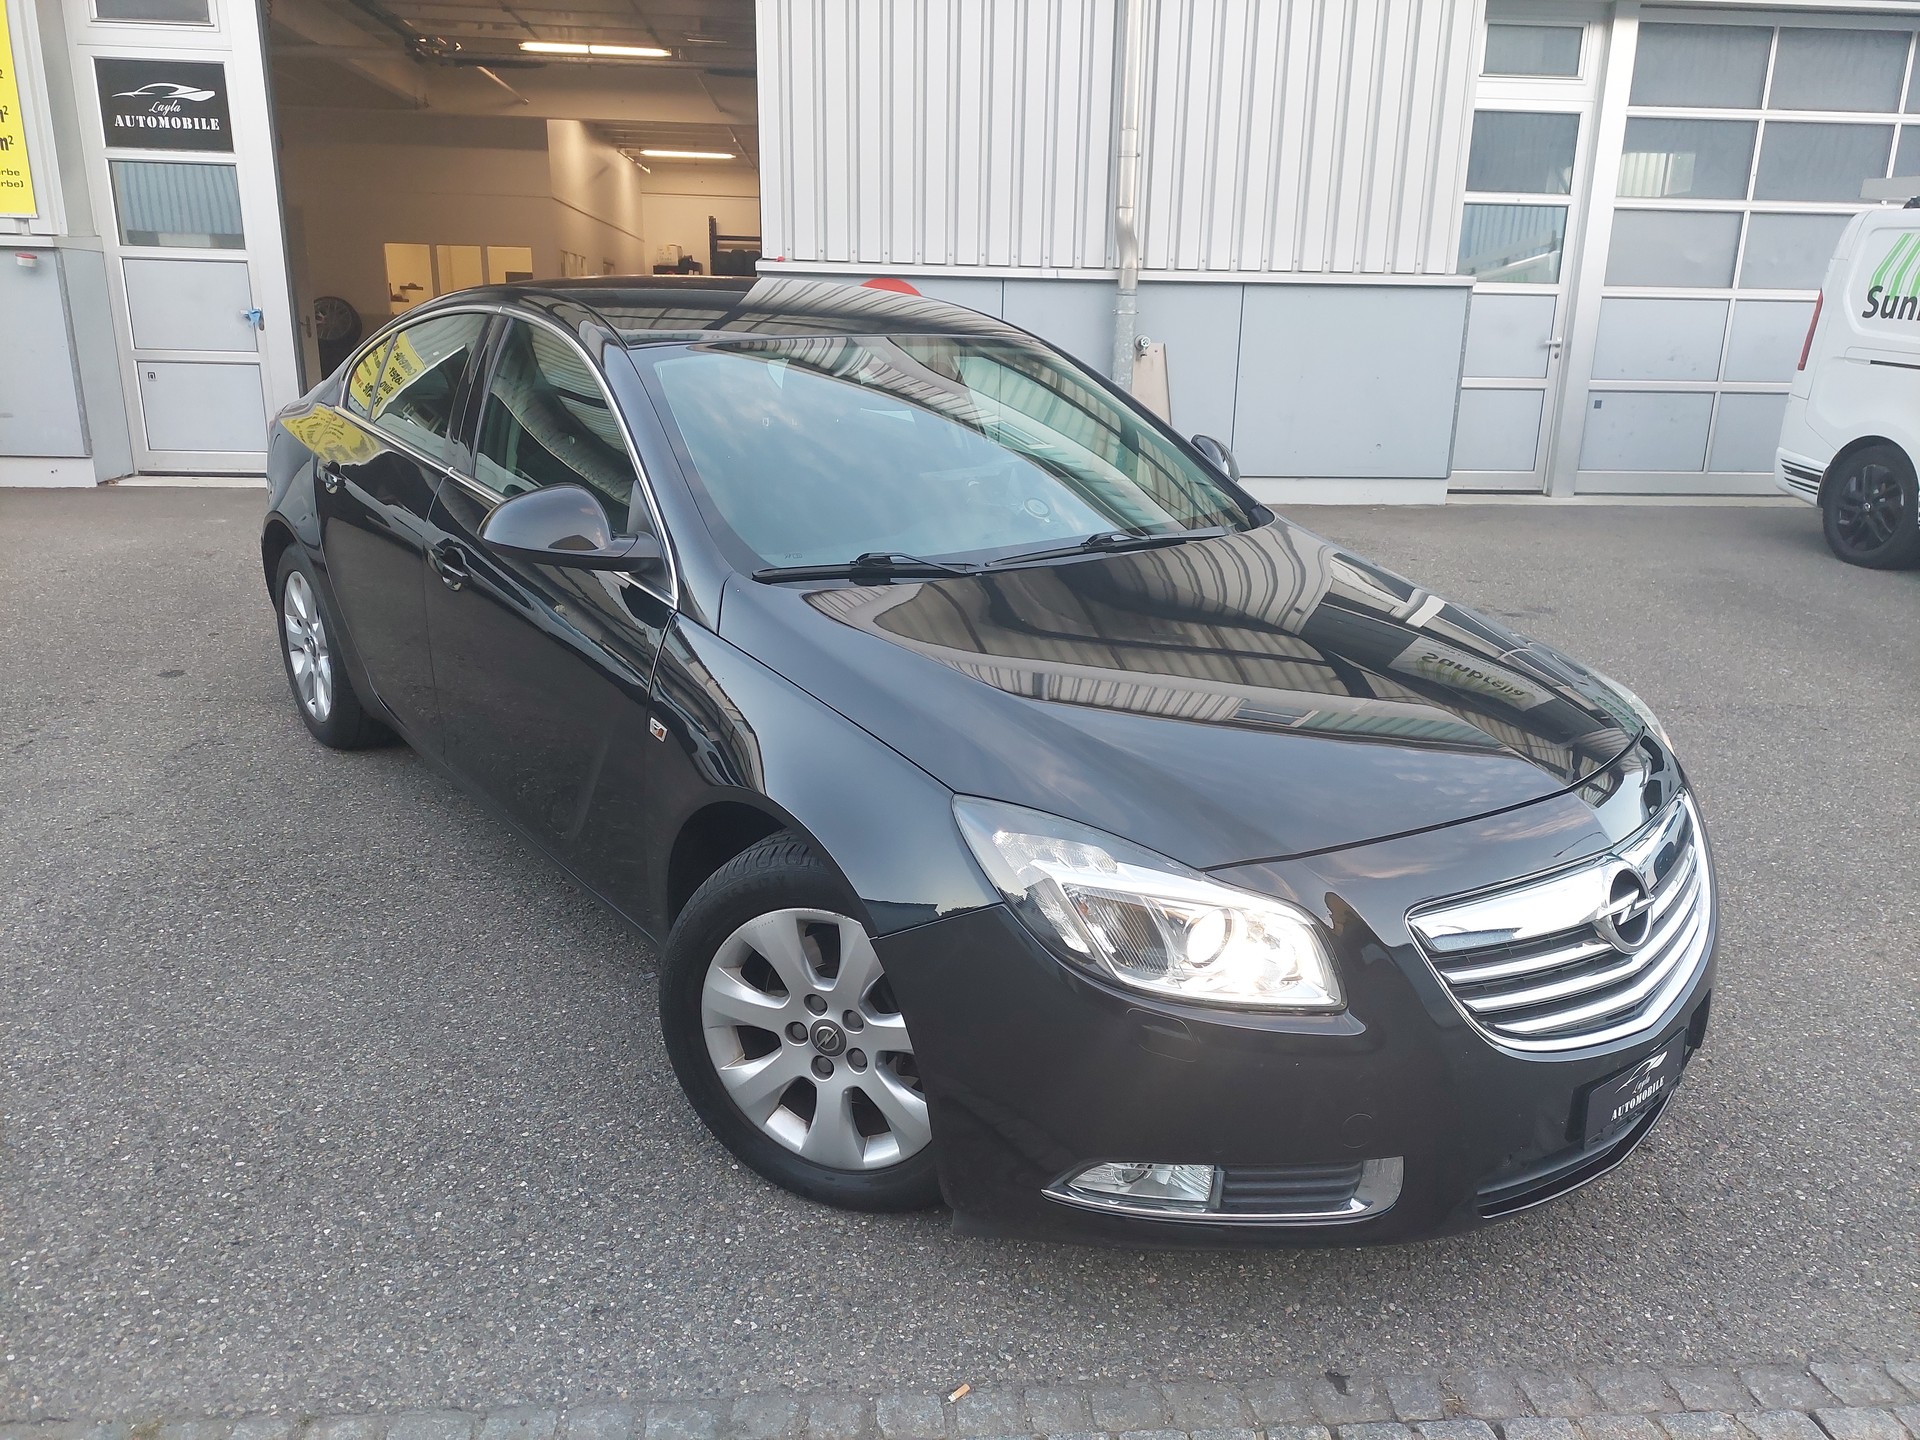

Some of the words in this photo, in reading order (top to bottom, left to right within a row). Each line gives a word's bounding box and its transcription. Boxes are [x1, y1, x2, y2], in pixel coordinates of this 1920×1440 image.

[148, 99, 182, 117] Layla
[114, 113, 220, 132] AUTOMOBILE
[1861, 285, 1920, 322] Sun
[1610, 1075, 1665, 1122] AUTOMOBILE
